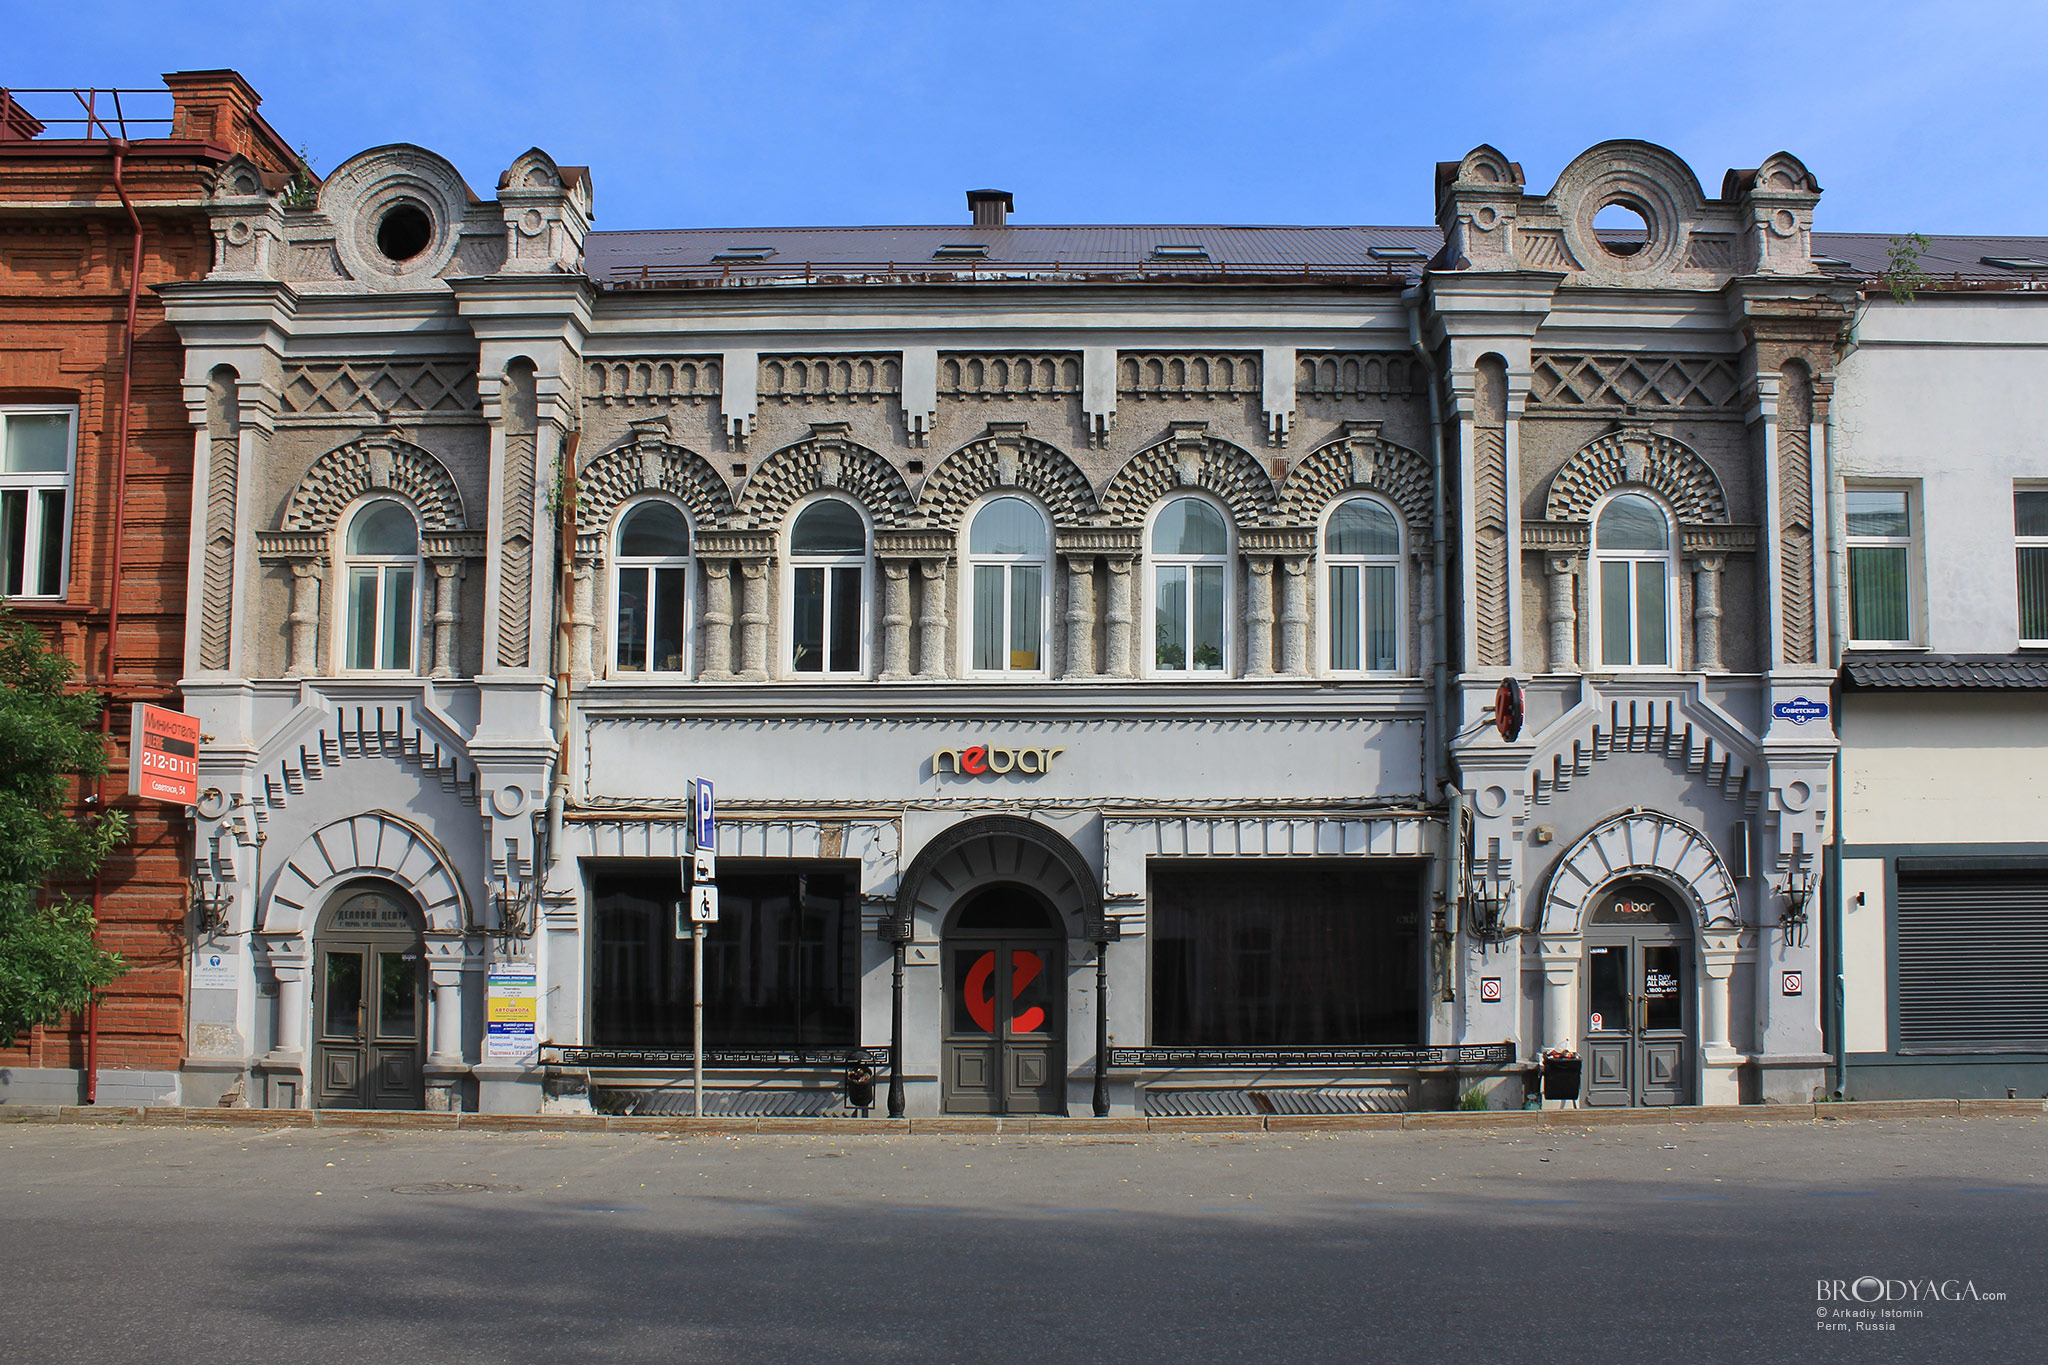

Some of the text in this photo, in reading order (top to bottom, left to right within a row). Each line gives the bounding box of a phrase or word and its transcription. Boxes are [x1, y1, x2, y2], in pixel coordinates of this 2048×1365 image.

[145, 712, 196, 739] Мини-отель
[144, 752, 196, 775] 212-0111
[932, 740, 1068, 775] nebar
[179, 784, 186, 795] 54
[700, 783, 712, 843] P
[338, 909, 377, 920] ДЕЛОВОЙ
[1614, 901, 1656, 913] nebar
